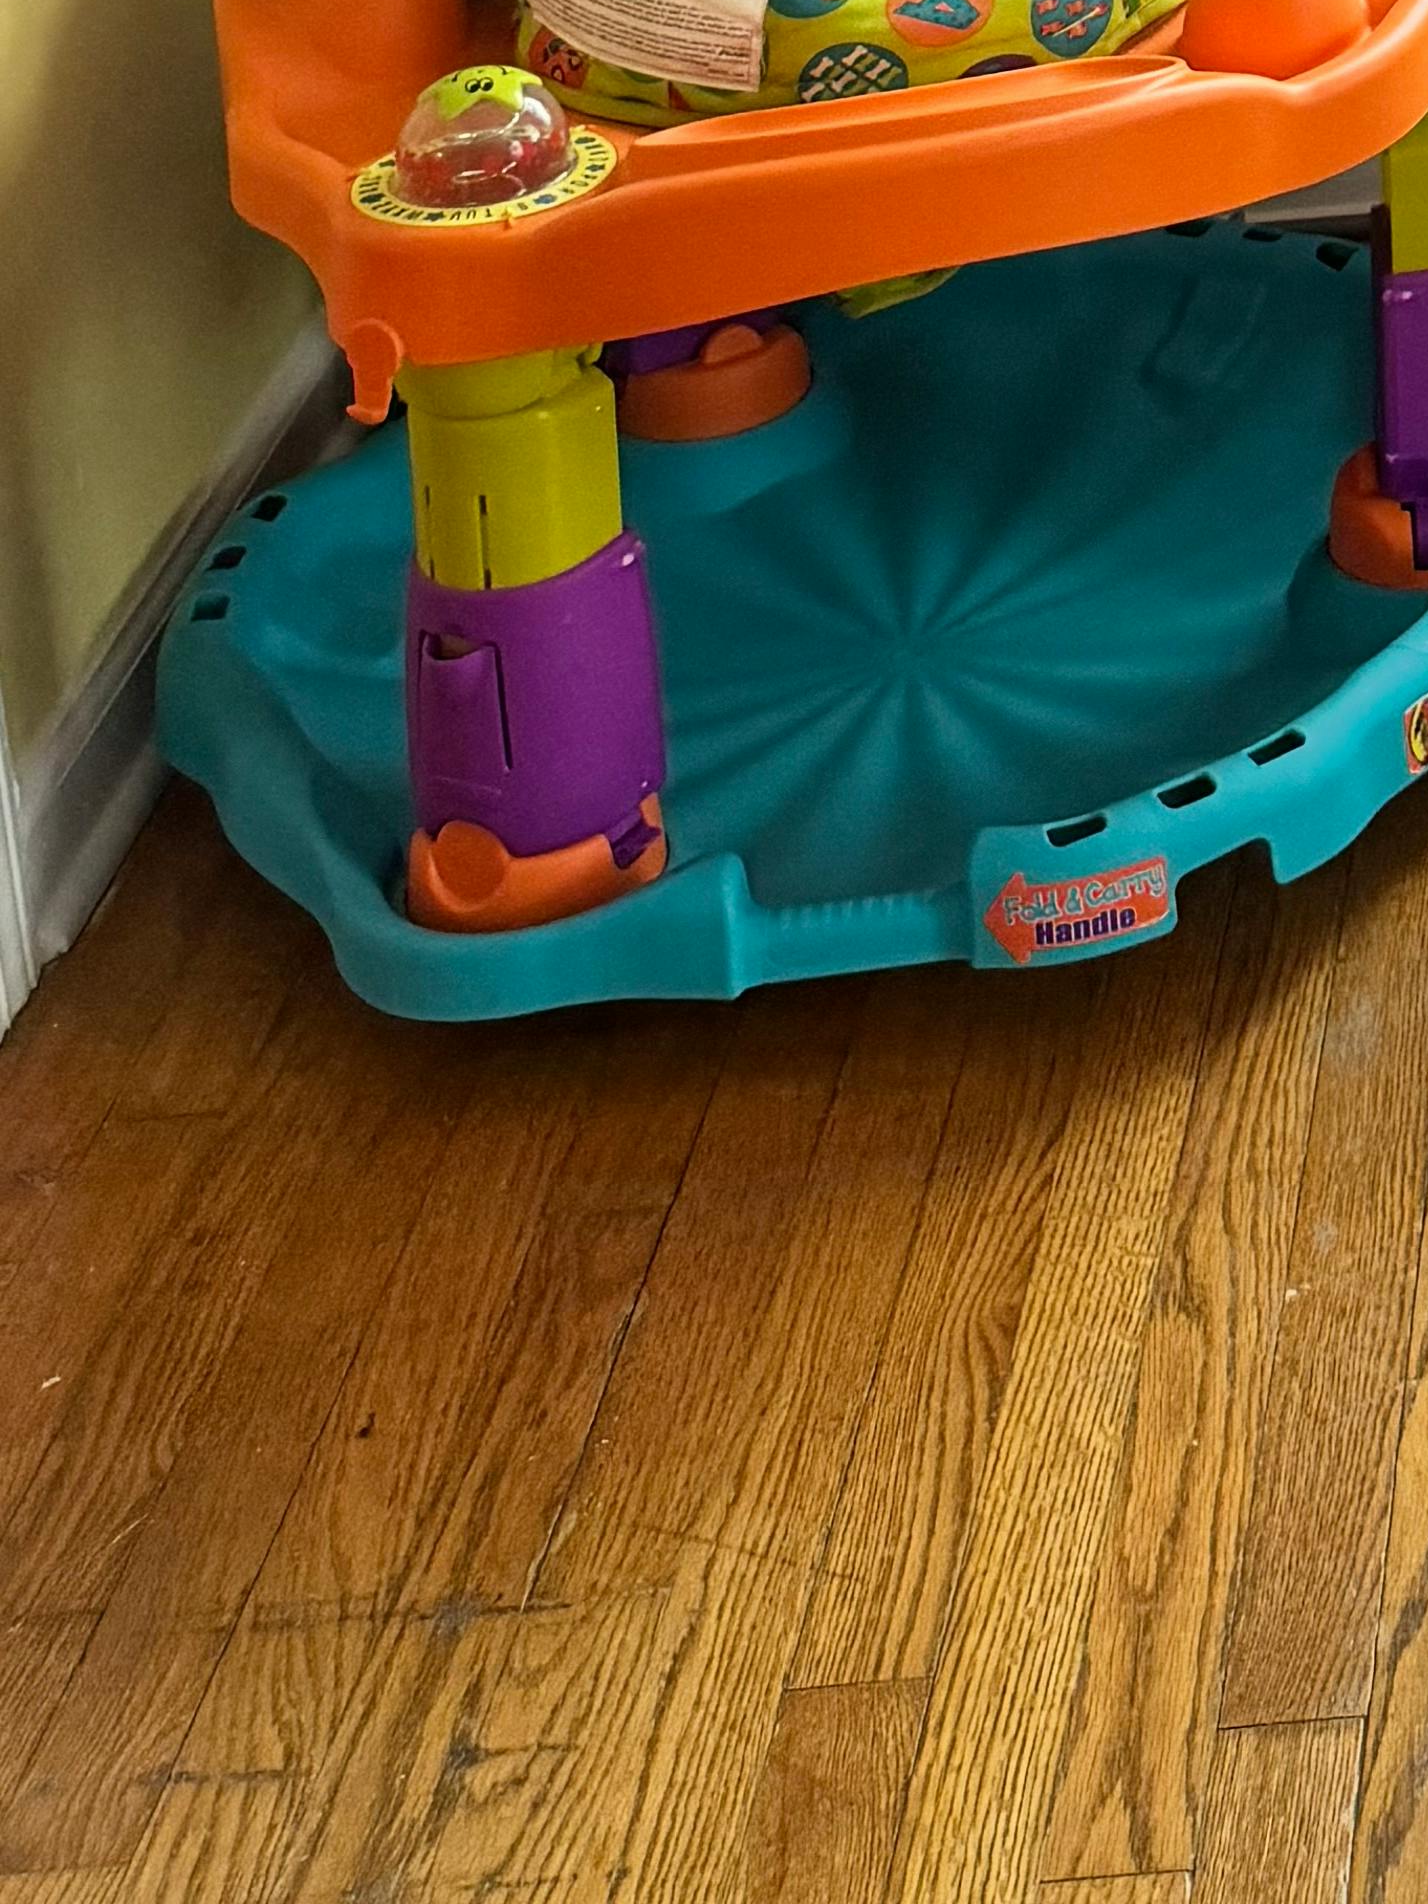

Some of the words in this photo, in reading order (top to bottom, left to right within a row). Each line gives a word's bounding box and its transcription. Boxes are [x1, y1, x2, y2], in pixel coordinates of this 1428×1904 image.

[1003, 887, 1061, 926] Fold
[1064, 886, 1084, 916] &
[1085, 863, 1166, 907] Carry
[1035, 907, 1136, 946] Handle
